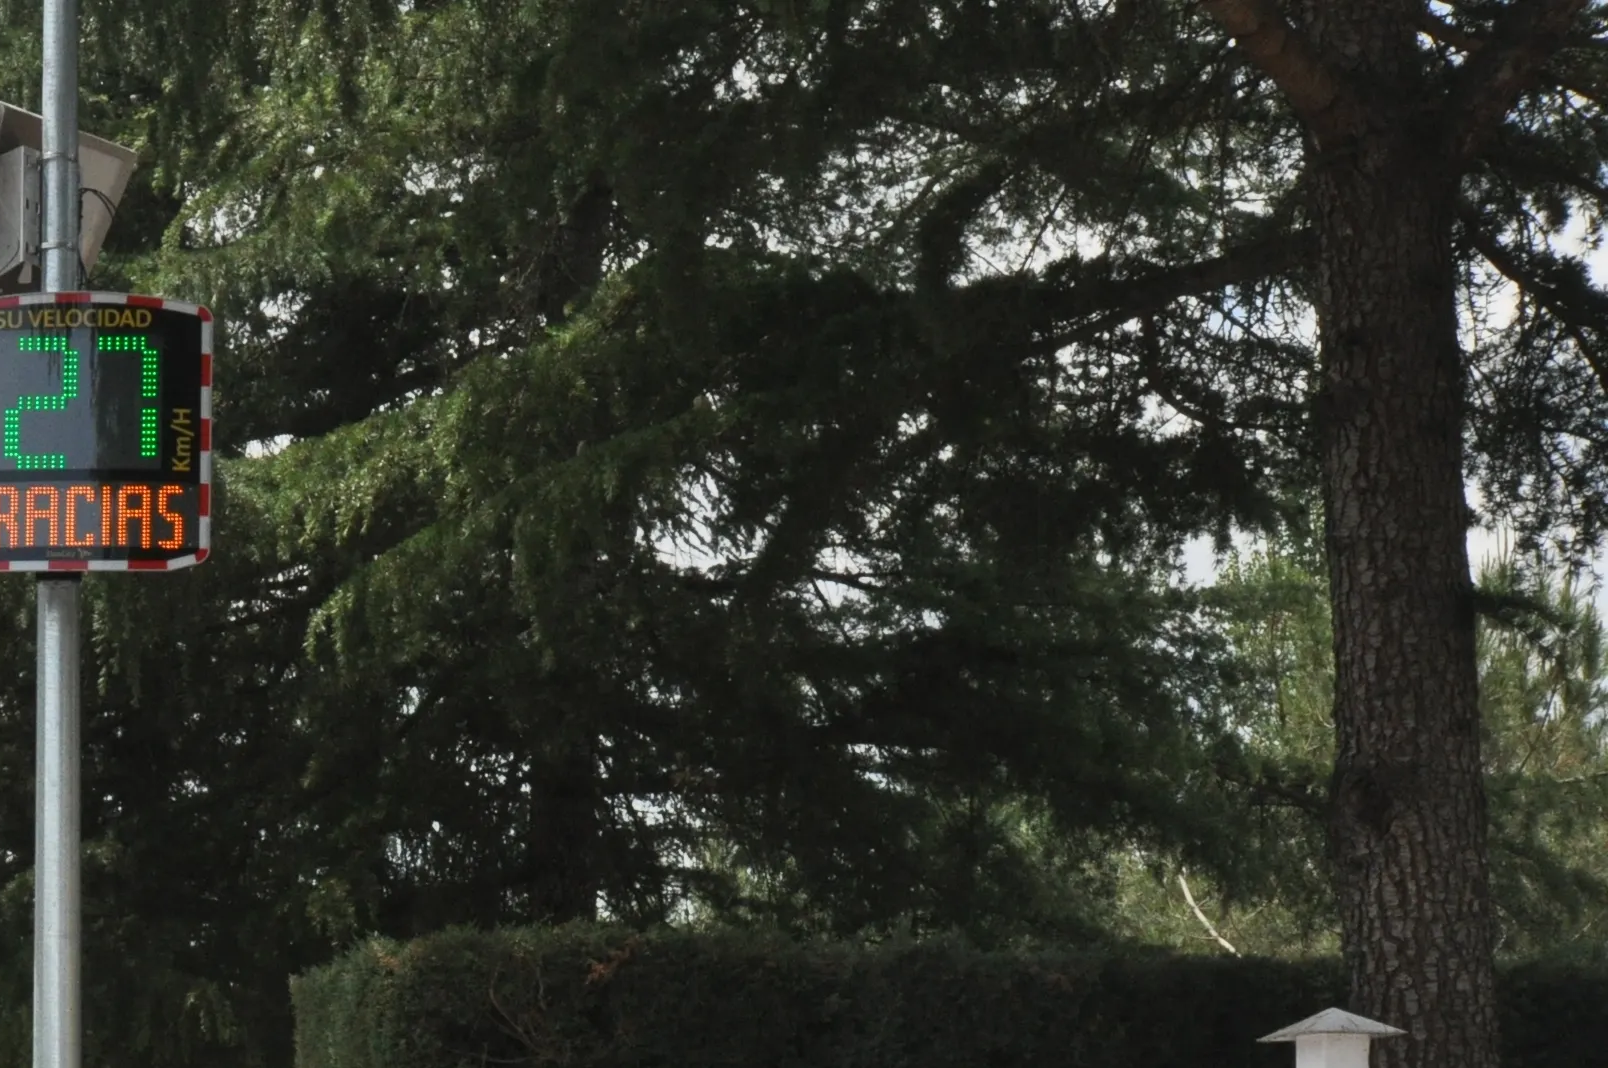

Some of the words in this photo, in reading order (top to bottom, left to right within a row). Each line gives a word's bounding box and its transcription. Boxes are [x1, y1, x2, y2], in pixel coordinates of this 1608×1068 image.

[28, 308, 152, 329] VELOCIDAD
[4, 336, 158, 469] 27
[171, 408, 193, 472] Km/H
